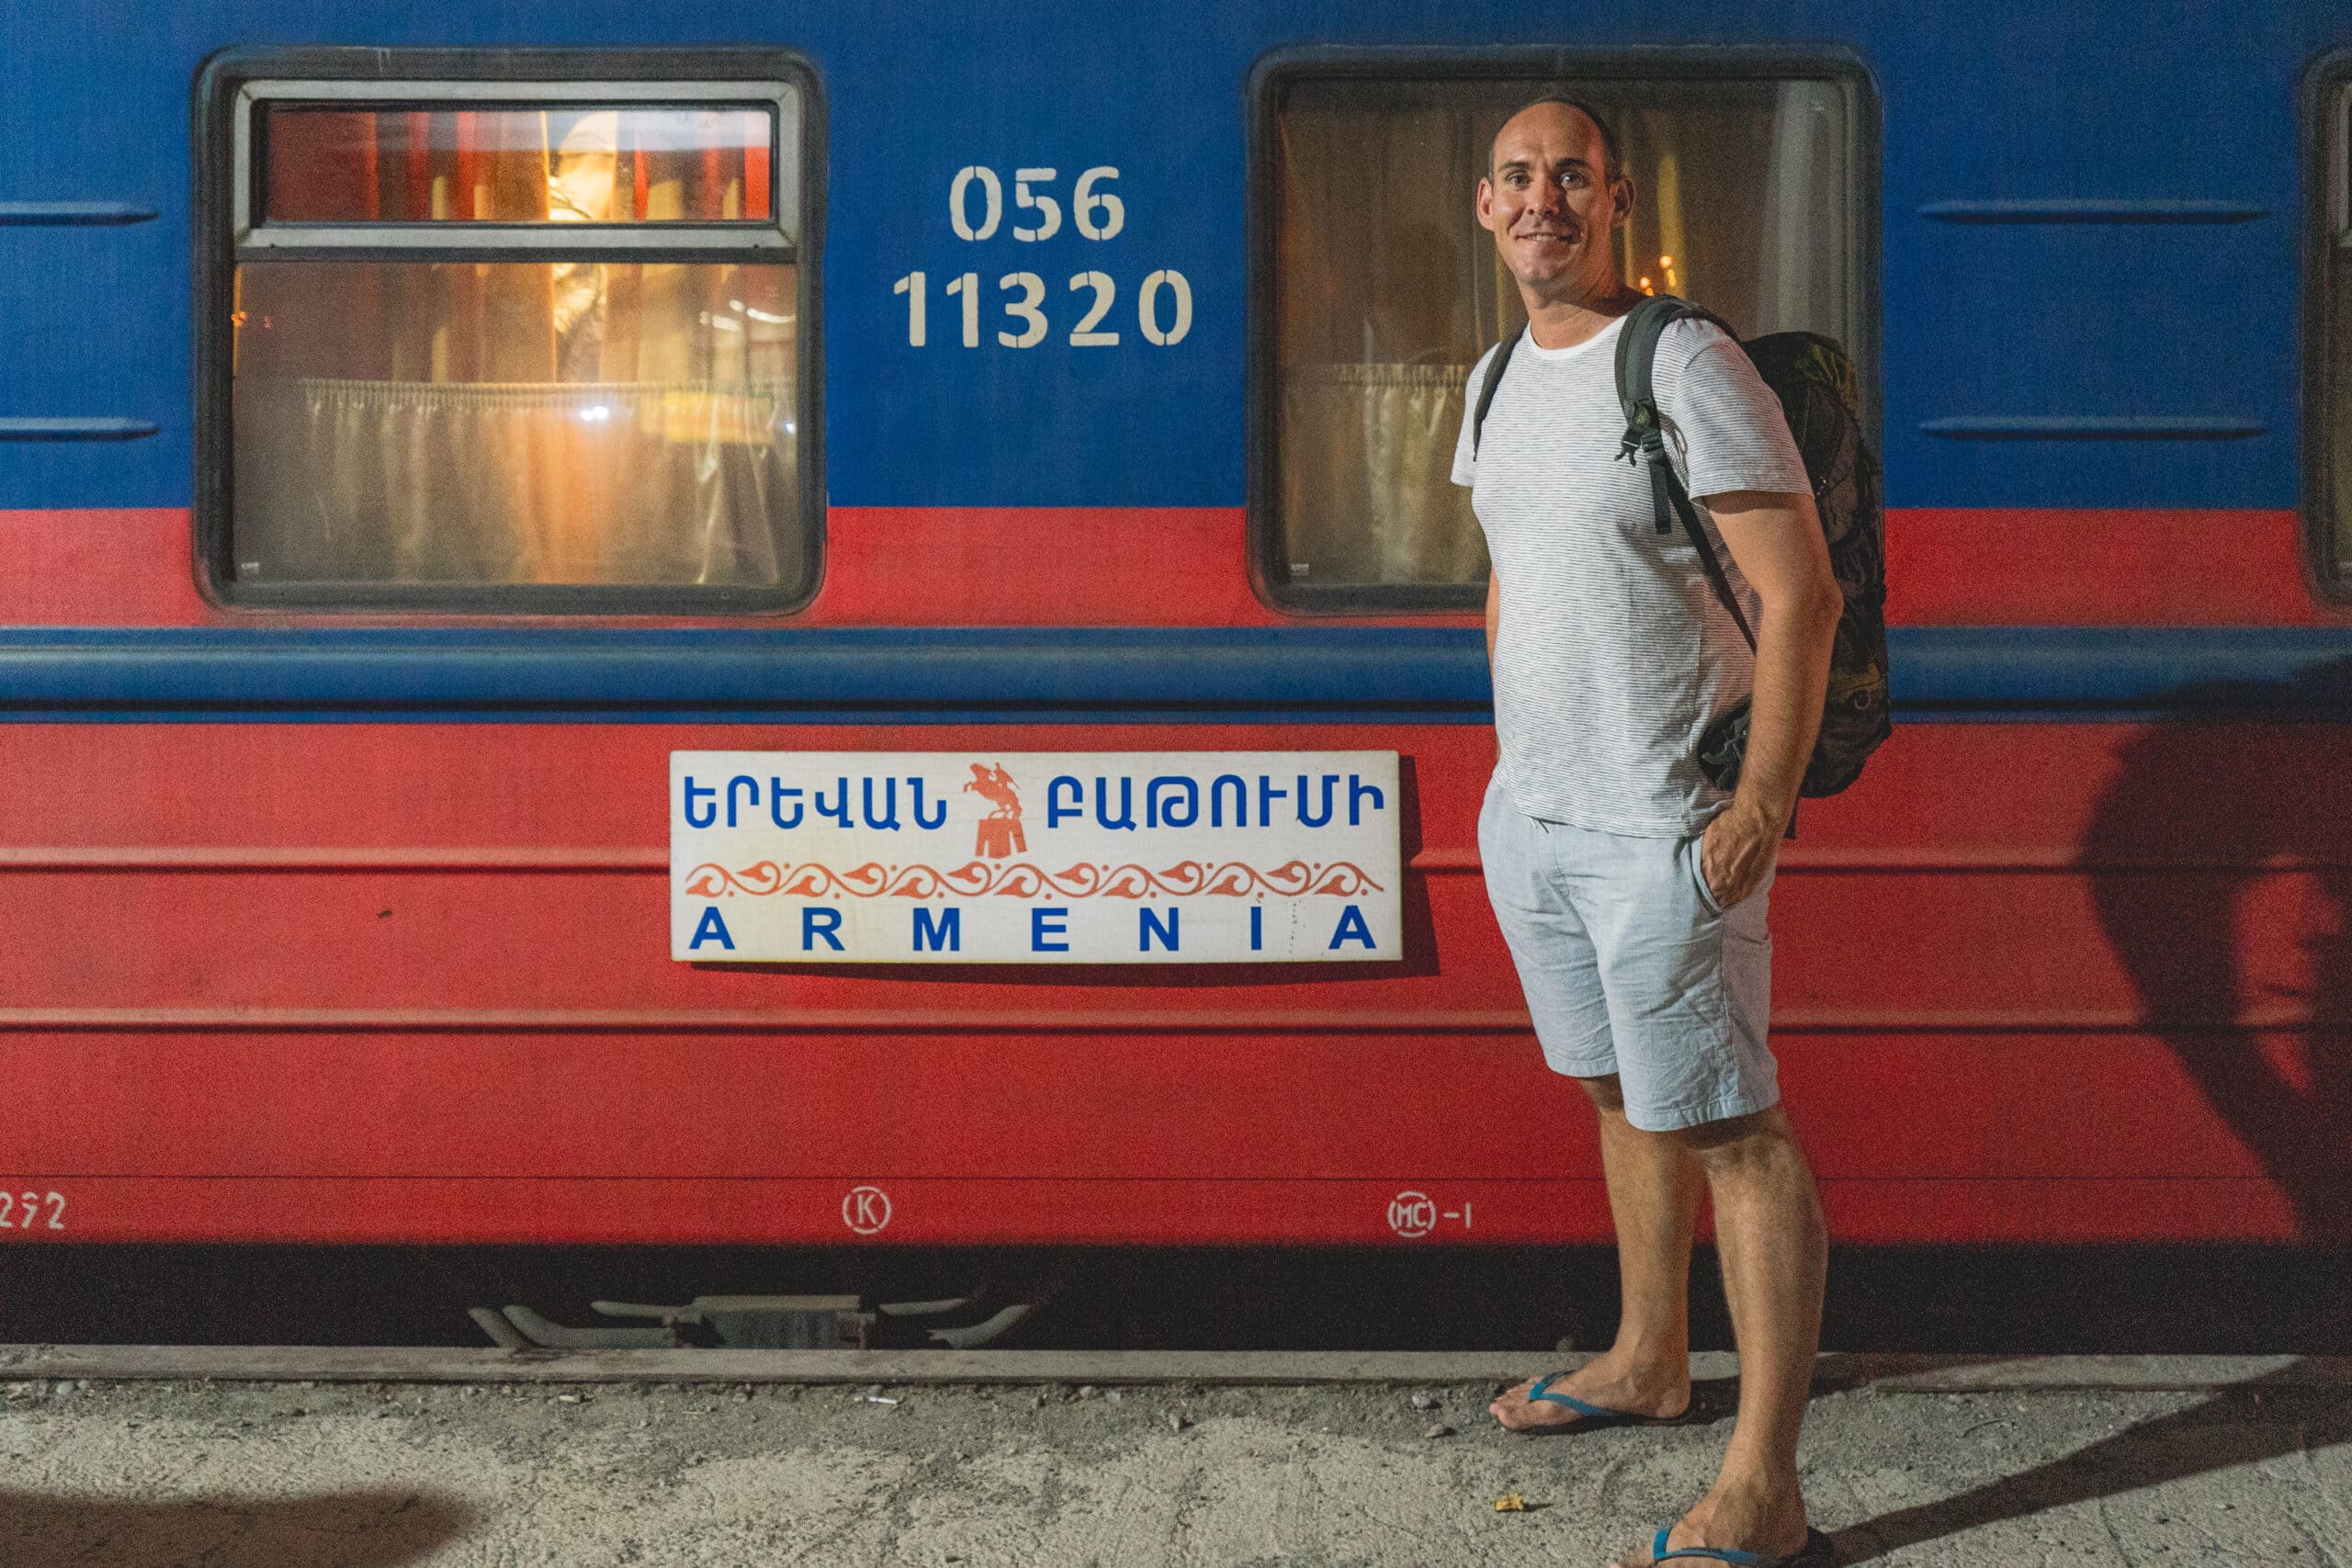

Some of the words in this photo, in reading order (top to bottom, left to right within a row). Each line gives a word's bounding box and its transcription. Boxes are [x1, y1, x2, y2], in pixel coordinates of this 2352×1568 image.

[949, 165, 1125, 243] 056
[893, 269, 1193, 348] 11320
[684, 774, 947, 831] ԵՐԵՎԱՆ
[1047, 773, 1384, 831] ԲԱԹՈՒՄԻ
[688, 905, 1376, 952] ARMENIA
